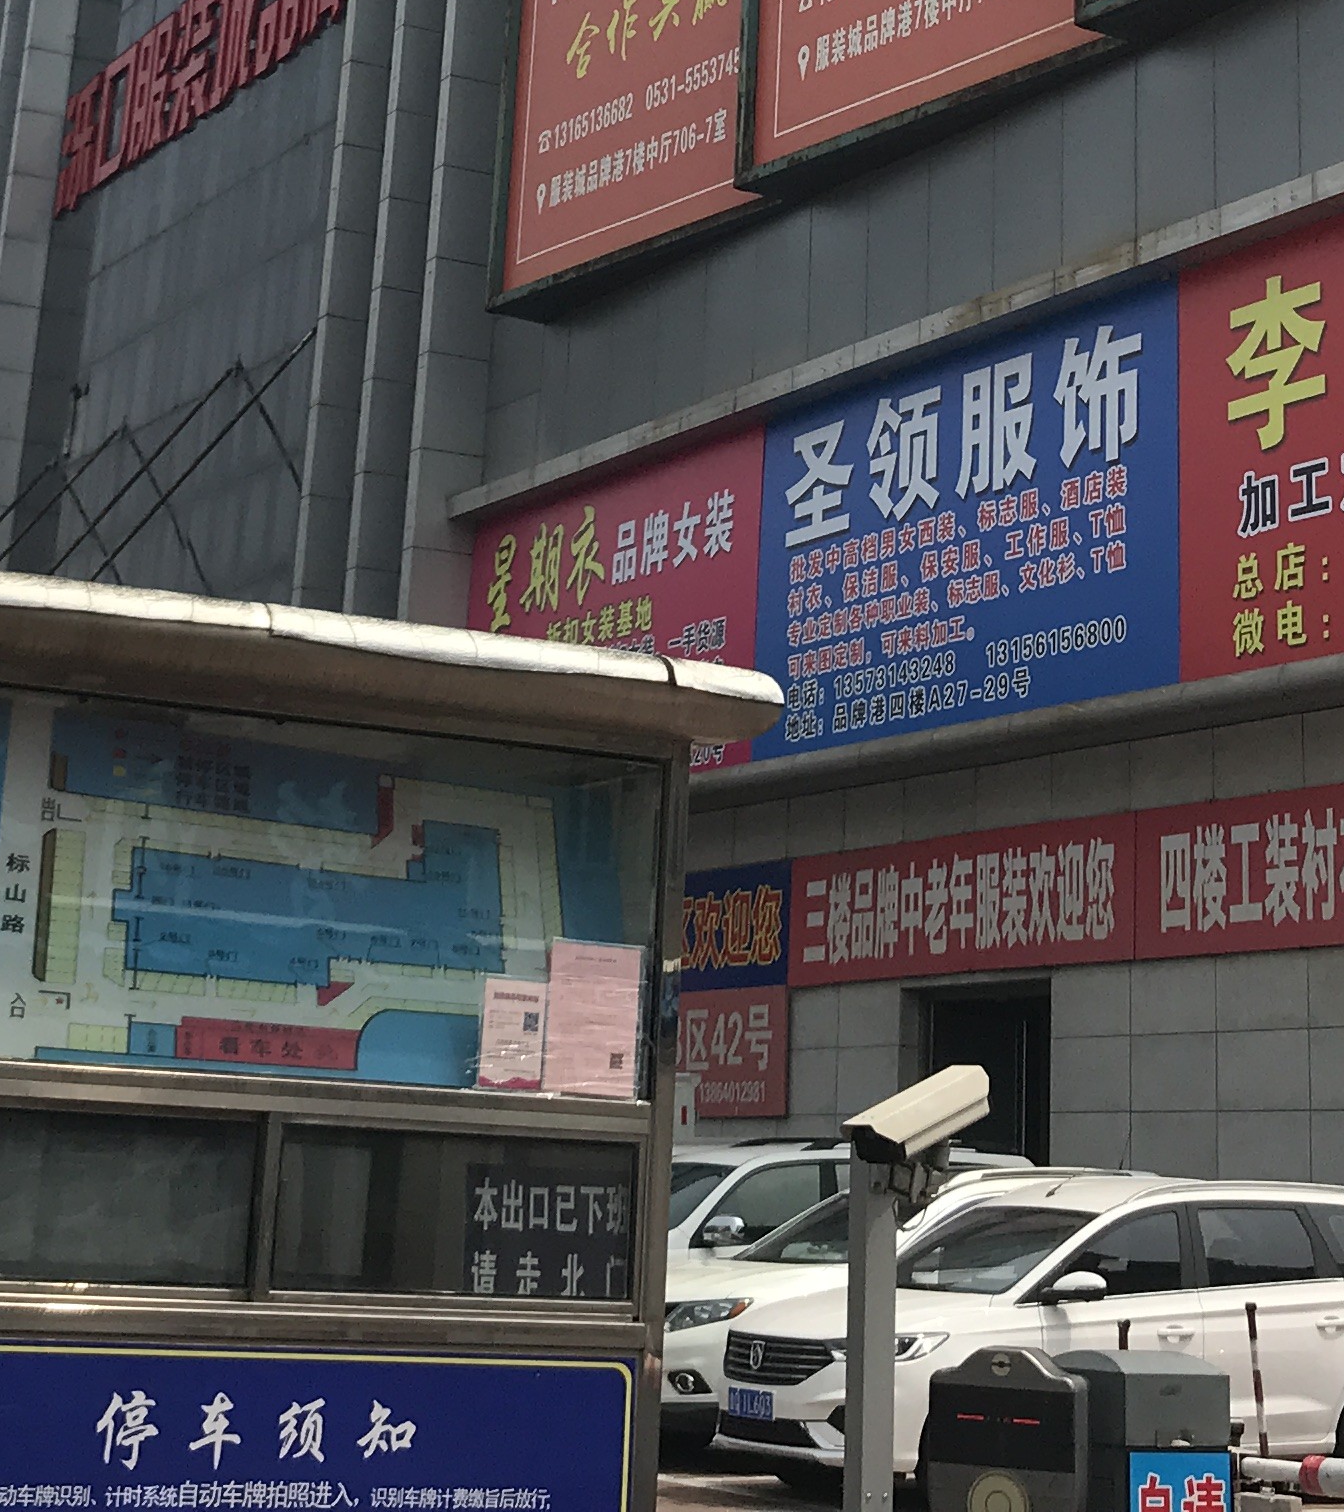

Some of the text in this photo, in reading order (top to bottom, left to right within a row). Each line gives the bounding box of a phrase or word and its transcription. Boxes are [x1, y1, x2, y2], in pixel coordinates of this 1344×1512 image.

[549, 106, 727, 208] 服装城品牌港7楼中厅706-7室
[554, 92, 635, 150] 13165136682
[785, 325, 1143, 548] 圣领服饰
[487, 488, 735, 633] 星期衣 品牌女装
[834, 652, 957, 701] 13573143248
[984, 614, 1127, 667] 13156156800
[831, 670, 1031, 734] 品牌港四楼A27-29号
[41, 797, 56, 822] 出口
[0, 852, 30, 934] 标山路
[802, 837, 1116, 965] 三楼品牌中老年服装欢迎您
[9, 993, 26, 1019] 入口
[676, 1004, 772, 1072] 区42号
[473, 1177, 629, 1236] 本出口已下班
[95, 1390, 418, 1471] 停车须知
